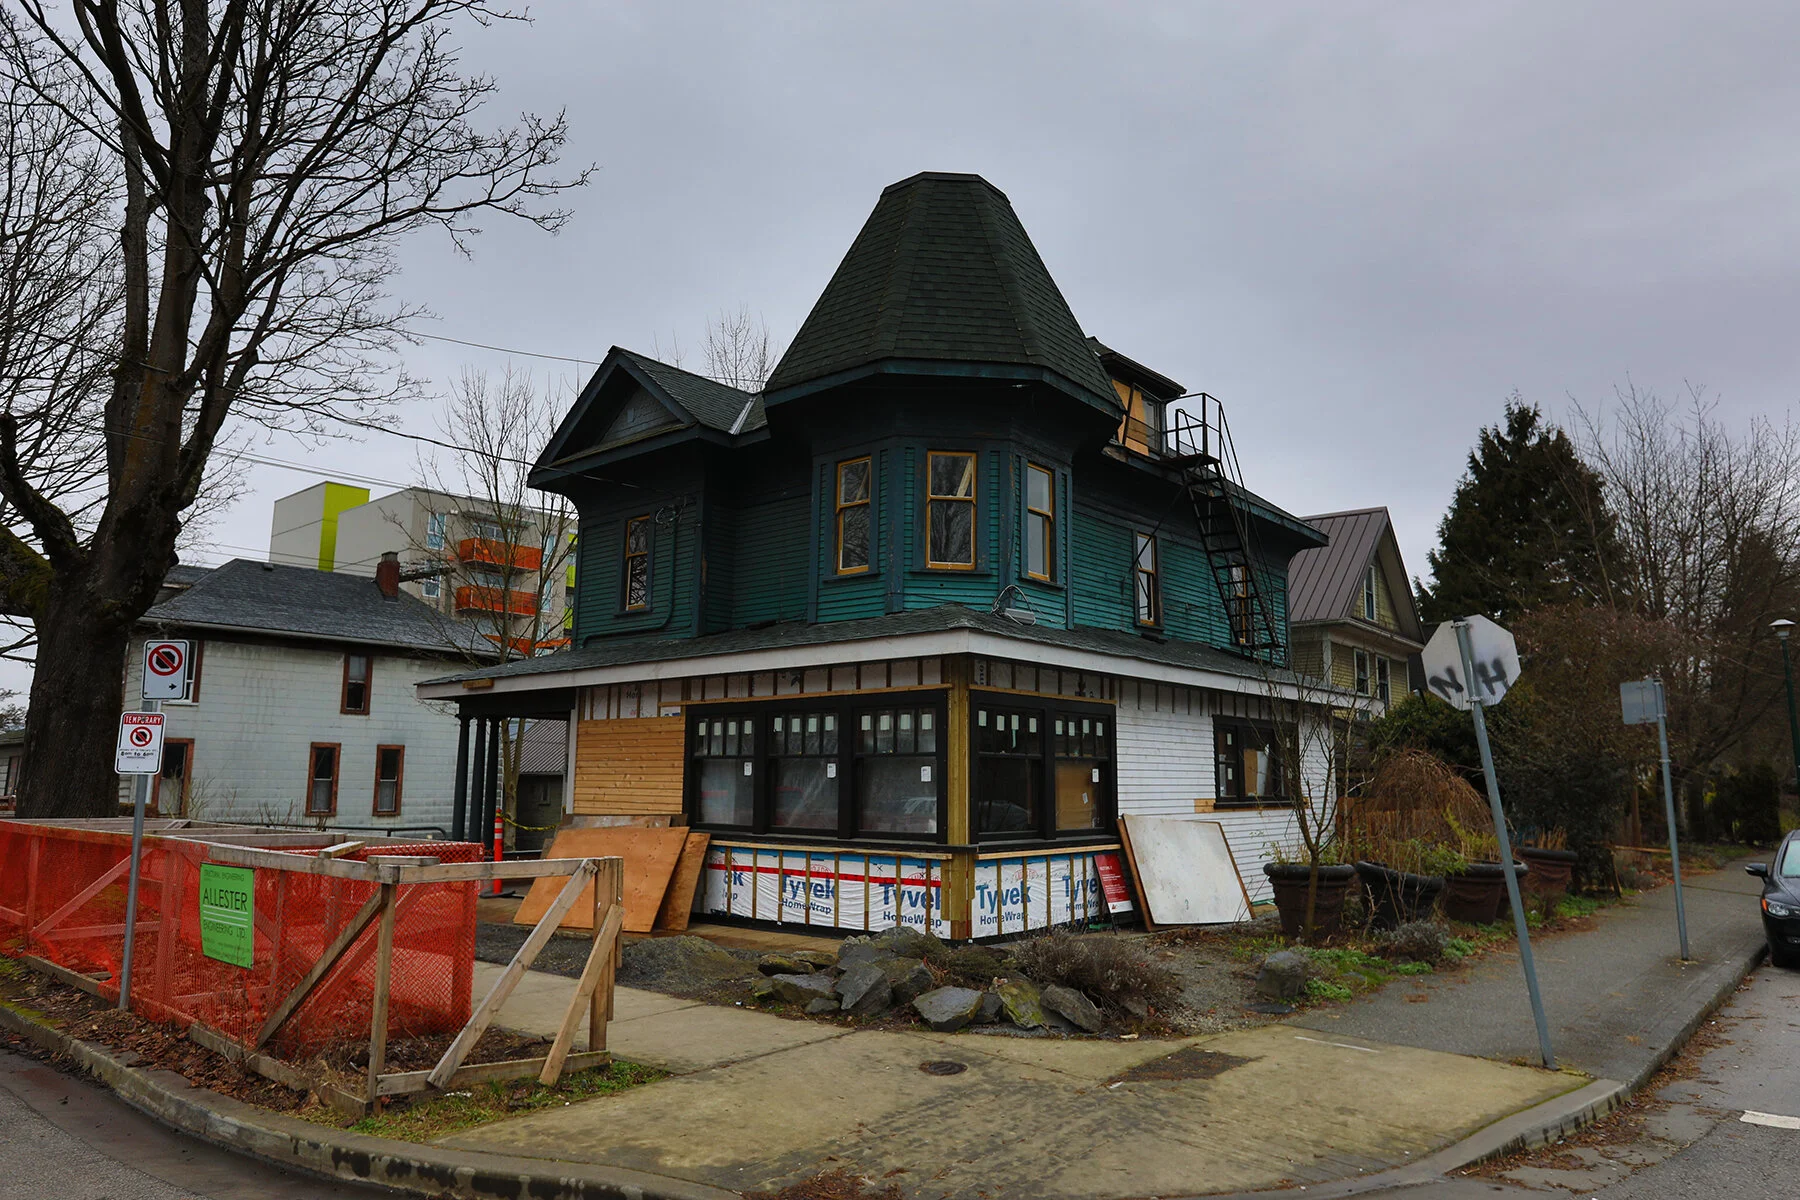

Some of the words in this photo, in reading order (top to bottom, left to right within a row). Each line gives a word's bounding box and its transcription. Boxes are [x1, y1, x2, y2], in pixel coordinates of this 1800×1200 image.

[126, 715, 162, 724] TEMPORARY
[202, 887, 248, 911] ALLESTER
[976, 880, 1032, 914] Tyvek
[883, 911, 942, 928] HomeWap
